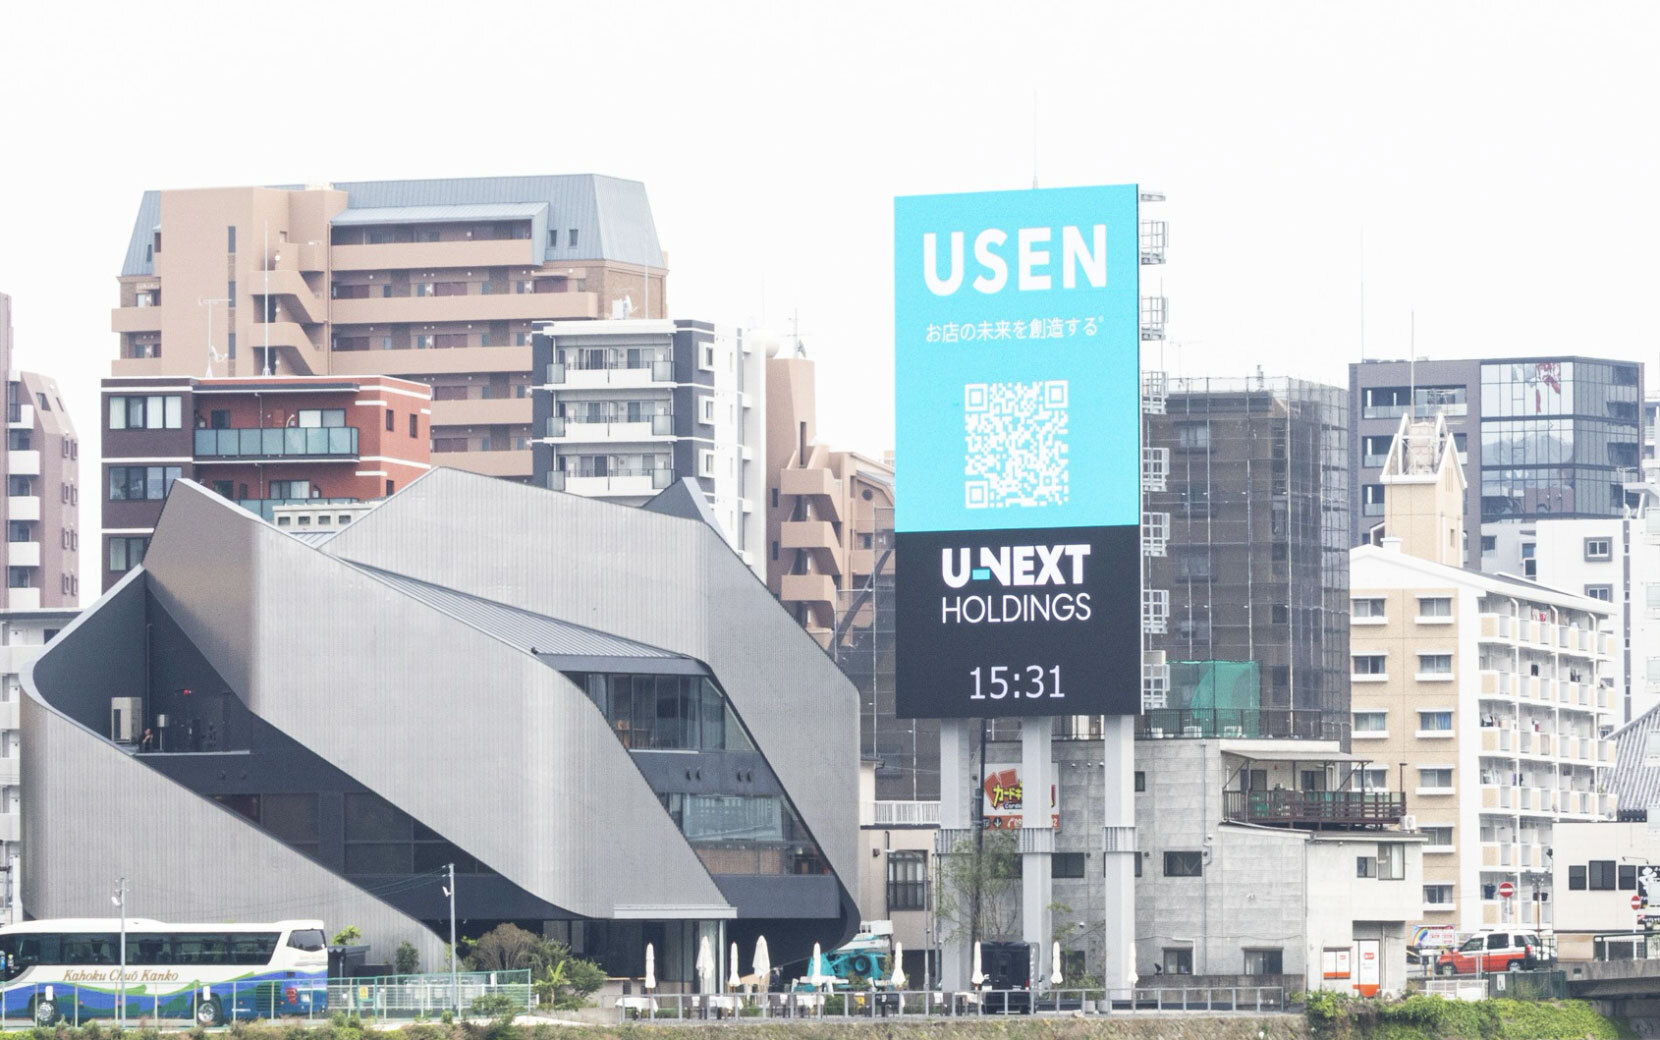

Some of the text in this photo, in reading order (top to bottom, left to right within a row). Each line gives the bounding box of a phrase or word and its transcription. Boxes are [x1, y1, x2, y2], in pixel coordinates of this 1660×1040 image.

[923, 224, 1107, 296] USEN
[925, 316, 1098, 343] お店の未来を創造する
[942, 544, 1091, 588] U-NEXT
[942, 592, 1091, 624] HOLDINGS
[969, 665, 1065, 699] 15:31
[62, 969, 106, 981] Kahoku
[141, 969, 179, 981] Kanko
